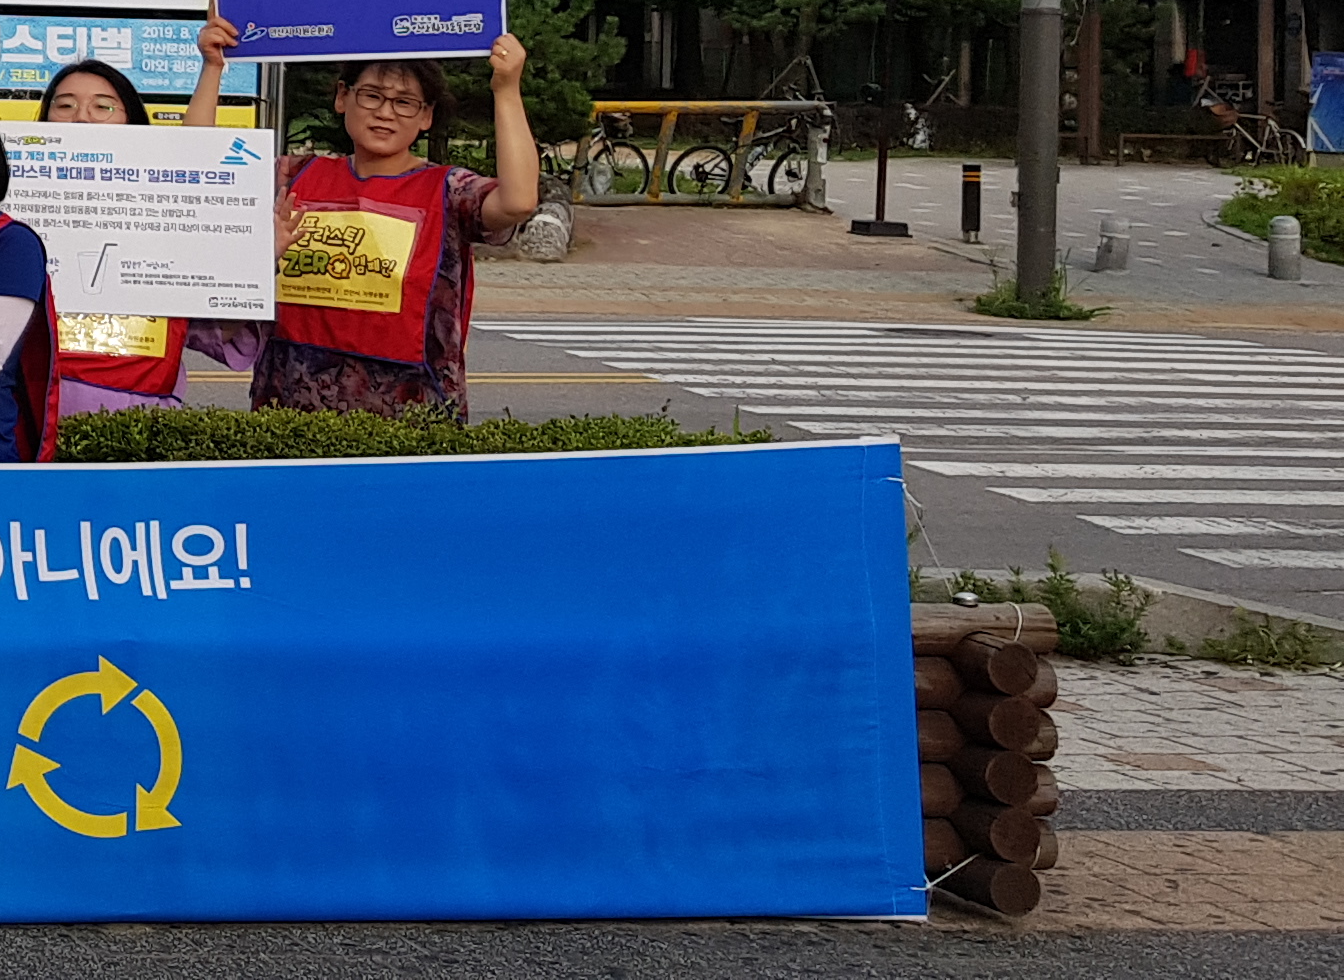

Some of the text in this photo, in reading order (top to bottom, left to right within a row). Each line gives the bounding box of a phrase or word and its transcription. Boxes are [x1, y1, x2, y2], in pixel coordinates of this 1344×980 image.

[100, 167, 141, 183] 법적인
[281, 250, 397, 280] ZERO 캠페인
